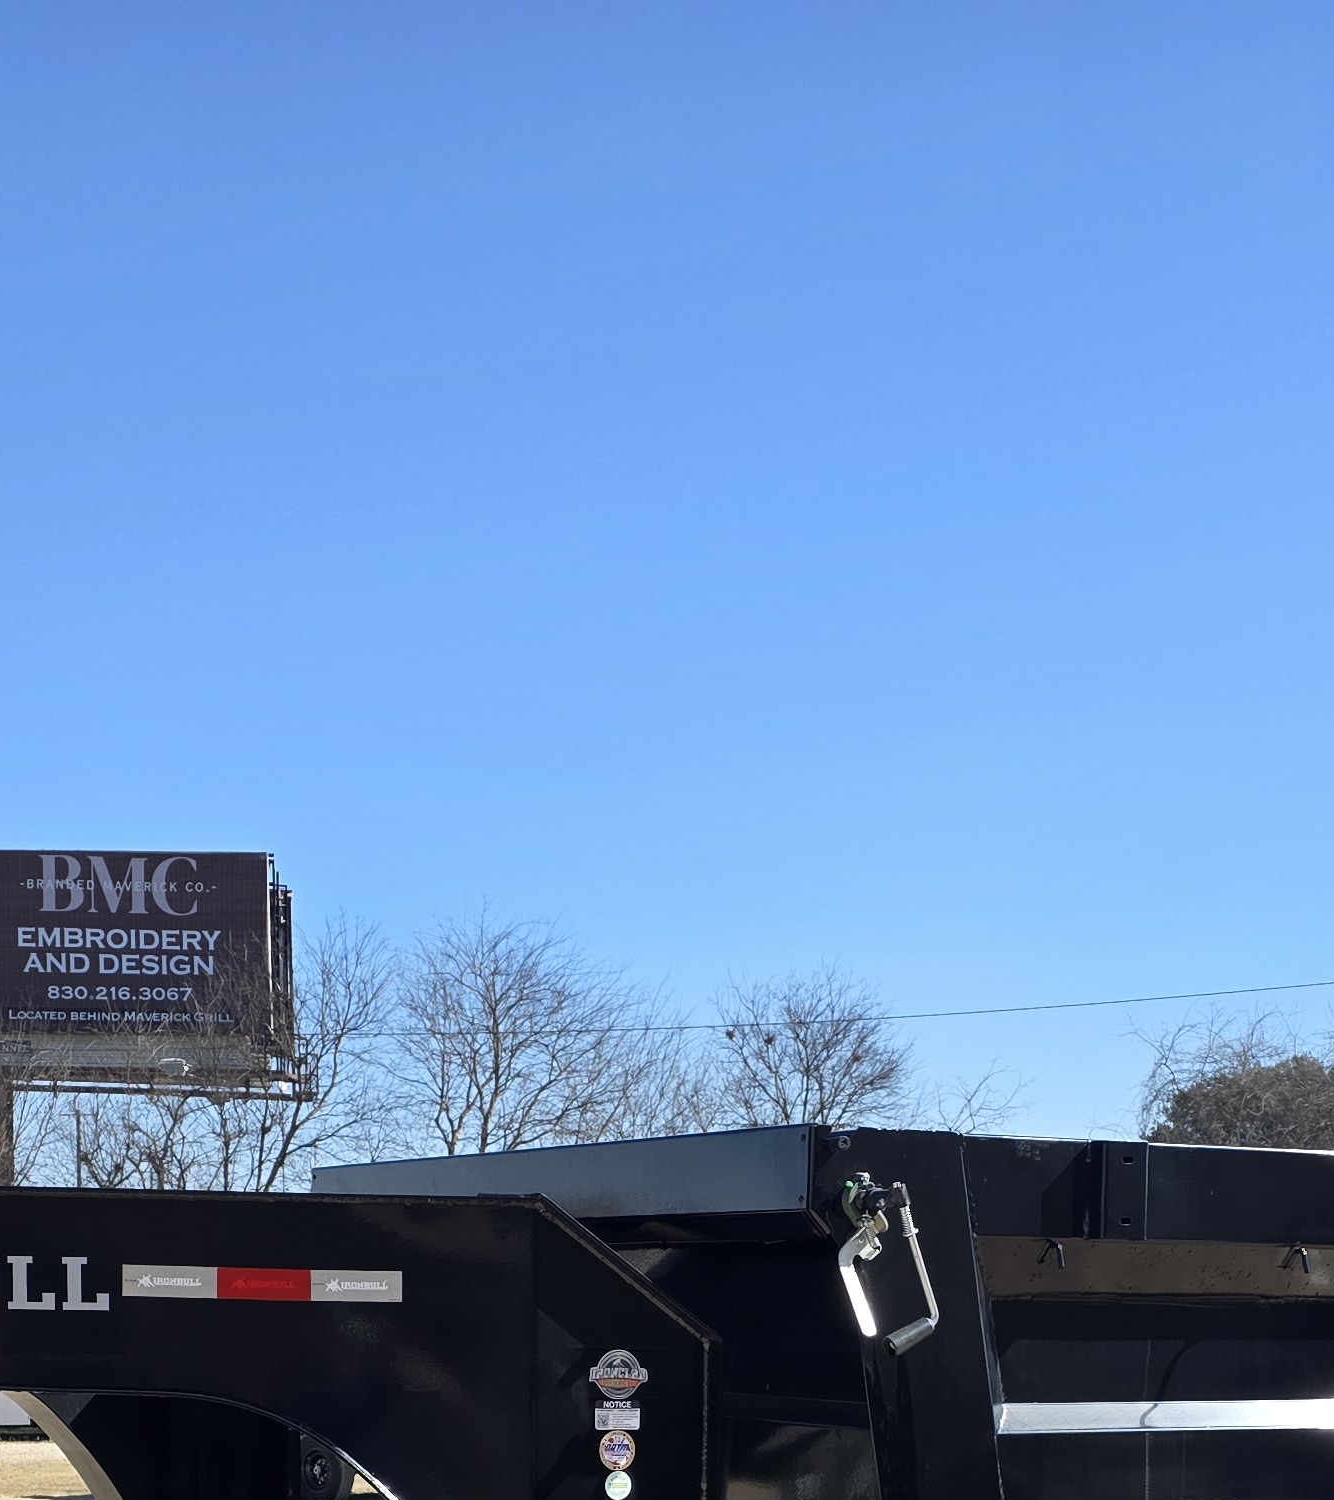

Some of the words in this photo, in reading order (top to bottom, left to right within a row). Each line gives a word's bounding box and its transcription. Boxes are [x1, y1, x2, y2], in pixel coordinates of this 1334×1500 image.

[39, 854, 198, 916] BMC
[103, 880, 178, 892] MAVERICK
[17, 927, 221, 951] EMBROIDERY
[23, 952, 90, 974] AND
[98, 953, 215, 976] DESIGN
[47, 985, 193, 1001] 830.216.3067
[603, 1401, 632, 1409] NOTICE
